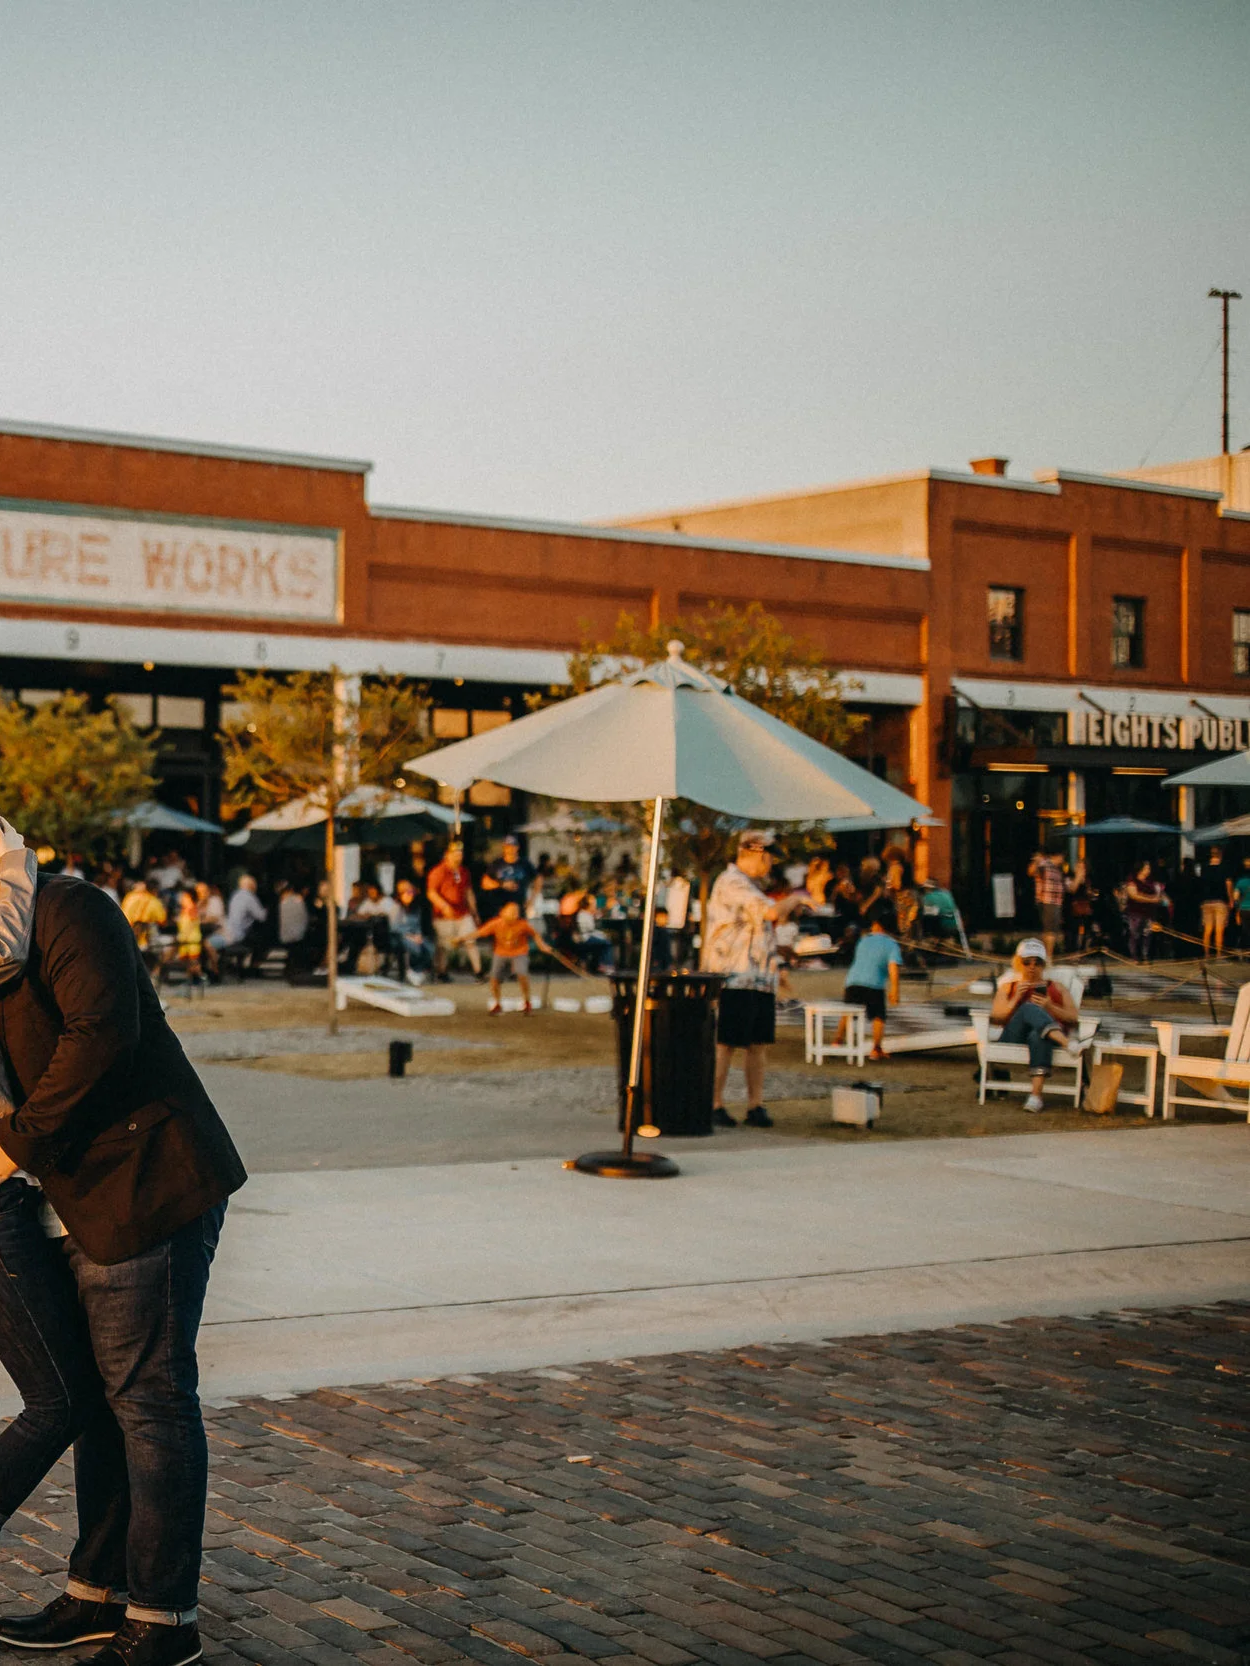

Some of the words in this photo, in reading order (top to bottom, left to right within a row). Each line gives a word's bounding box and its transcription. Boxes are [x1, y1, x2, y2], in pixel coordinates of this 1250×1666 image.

[141, 540, 318, 598] WORKS
[1069, 711, 1178, 748] HEIGHTS
[1186, 716, 1250, 750] PUBL
